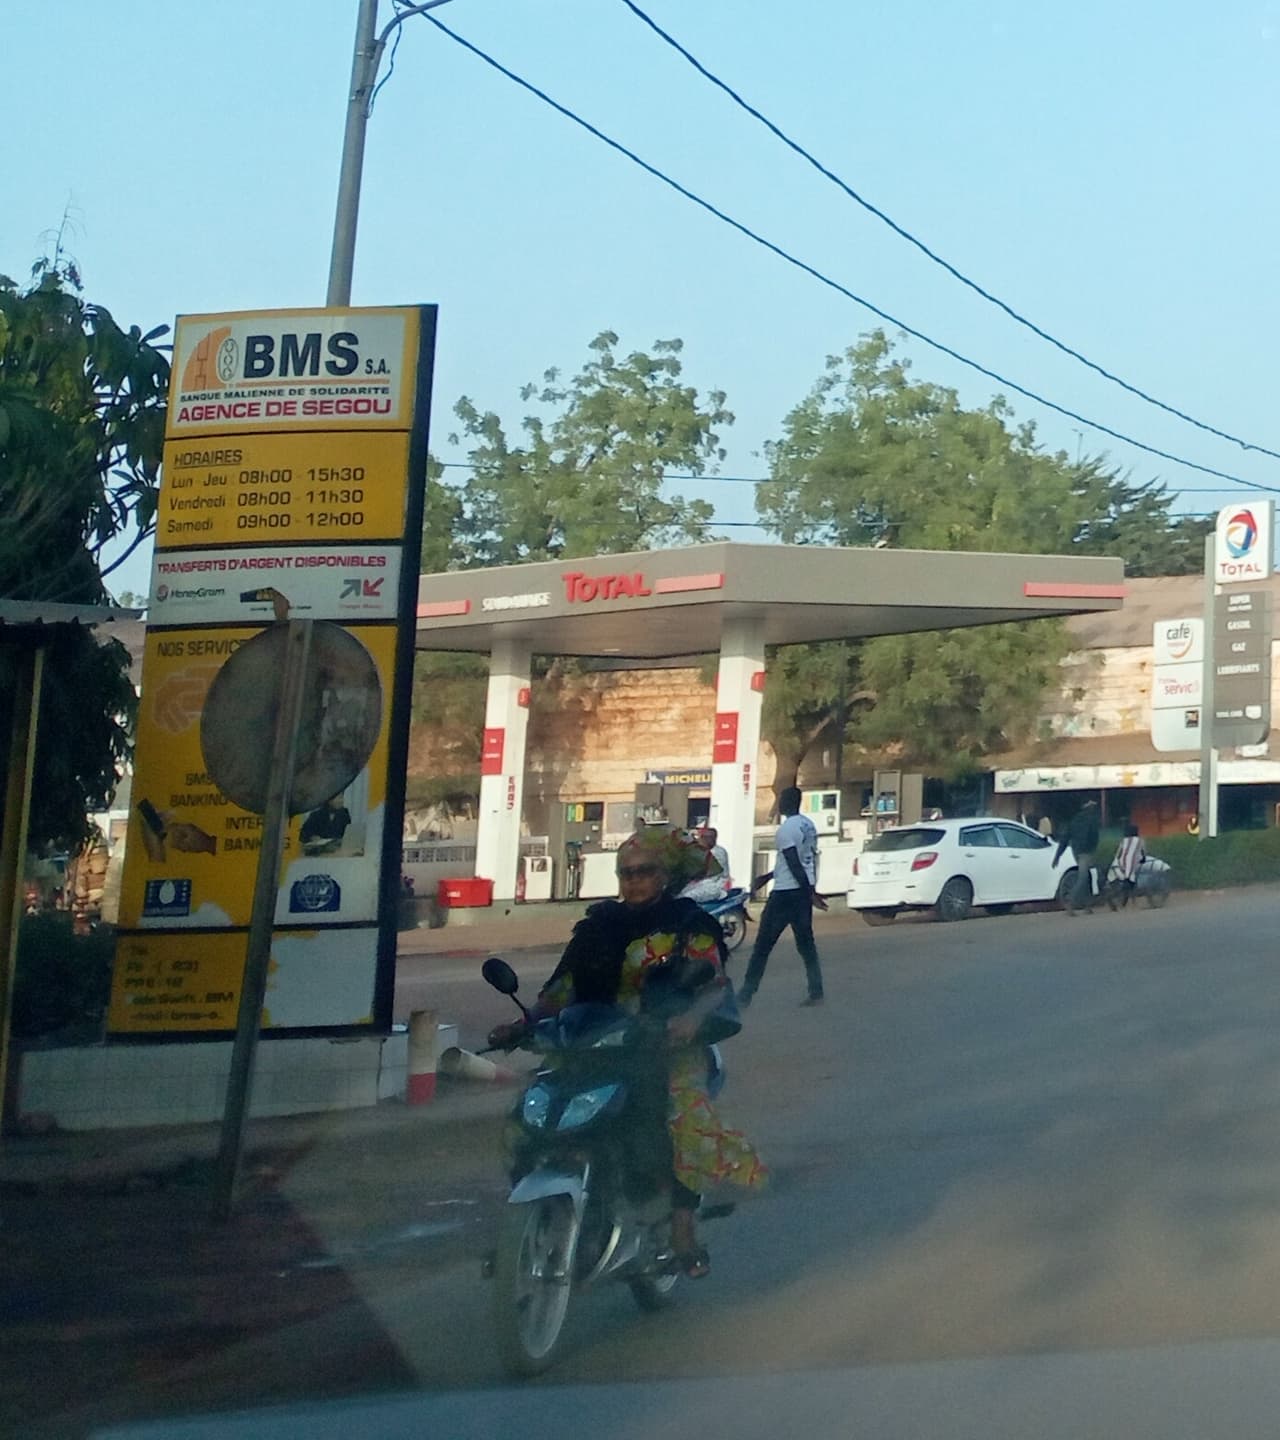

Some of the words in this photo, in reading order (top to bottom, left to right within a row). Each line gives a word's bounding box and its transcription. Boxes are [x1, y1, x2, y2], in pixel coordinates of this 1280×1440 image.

[243, 332, 359, 379] BMS
[364, 358, 391, 375] S.A.
[180, 392, 221, 402] BANQUE
[223, 388, 284, 398] MALIENNE
[288, 388, 305, 396] DE
[309, 386, 390, 396] SOLIDARITE
[177, 402, 260, 422] AGENCE
[265, 400, 297, 417] DE
[302, 398, 392, 416] SEGOU
[174, 449, 243, 467] HORAIRES
[171, 476, 193, 489] Lun
[202, 472, 227, 487] Jeu
[238, 469, 292, 485] 08h00
[307, 467, 365, 482] 15h30
[169, 495, 226, 511] Vendredi
[237, 491, 291, 507] 08h00
[306, 489, 364, 504] 11h30
[167, 519, 214, 533] Samedi
[236, 514, 291, 529] 09h00
[306, 512, 364, 527] 12h00
[157, 560, 226, 575] TRANSFERTS
[228, 557, 293, 570] D'ARGENT
[295, 556, 387, 568] DISPONIBLES
[1220, 562, 1263, 576] TOTAL
[561, 571, 652, 603] TOTAL
[1166, 622, 1191, 641] café
[157, 641, 186, 657] NOS
[188, 638, 244, 656] SERVIC
[664, 774, 711, 785] MICHELI
[225, 816, 292, 831] INTERT
